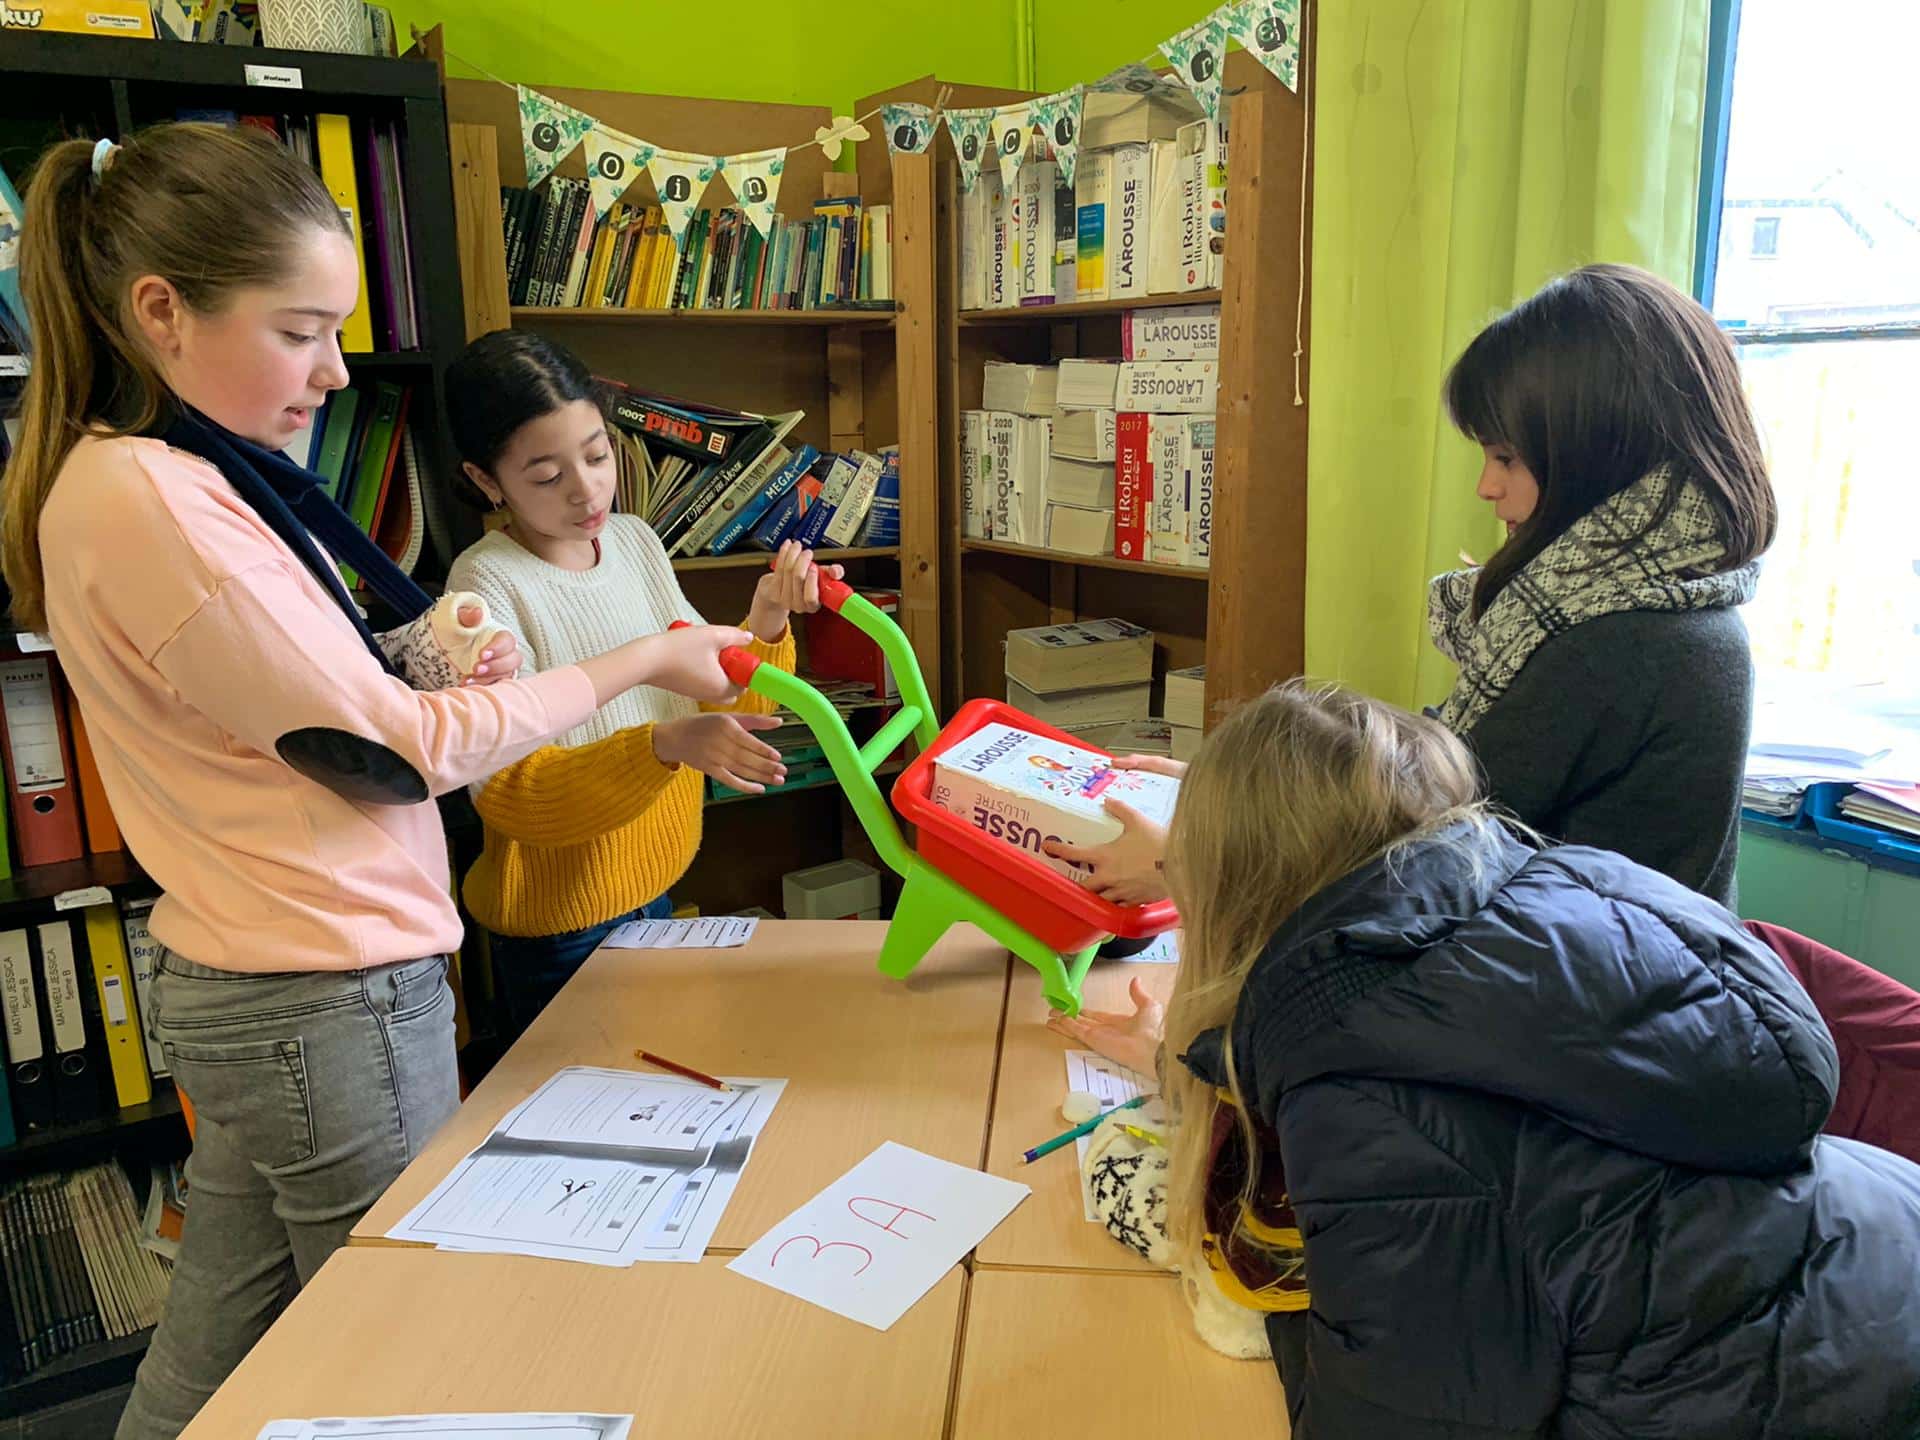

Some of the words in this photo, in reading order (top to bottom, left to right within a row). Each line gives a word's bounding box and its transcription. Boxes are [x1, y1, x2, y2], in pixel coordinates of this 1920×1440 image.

[1025, 195, 1037, 293] LAROUSSE
[1121, 179, 1136, 288] LAROUSSE
[994, 222, 1004, 304] LAROUSSE
[1143, 324, 1217, 342] LAROUSSE
[1131, 379, 1204, 395] LAROUSSE
[617, 406, 646, 423] 2000
[1120, 421, 1142, 431] 2017
[765, 471, 794, 499] MEGA
[997, 432, 1009, 536] LAROUSSE
[1162, 435, 1175, 532] LAROUSSE
[1198, 450, 1214, 557] LAROUSSE
[716, 523, 743, 552] NATHAN
[962, 731, 1029, 773] LAROUSSE
[3, 955, 17, 995] JESSICA
[46, 946, 60, 985] JESSICA
[8, 995, 22, 1036] MATHIEU
[52, 986, 65, 1027] MATHIEU
